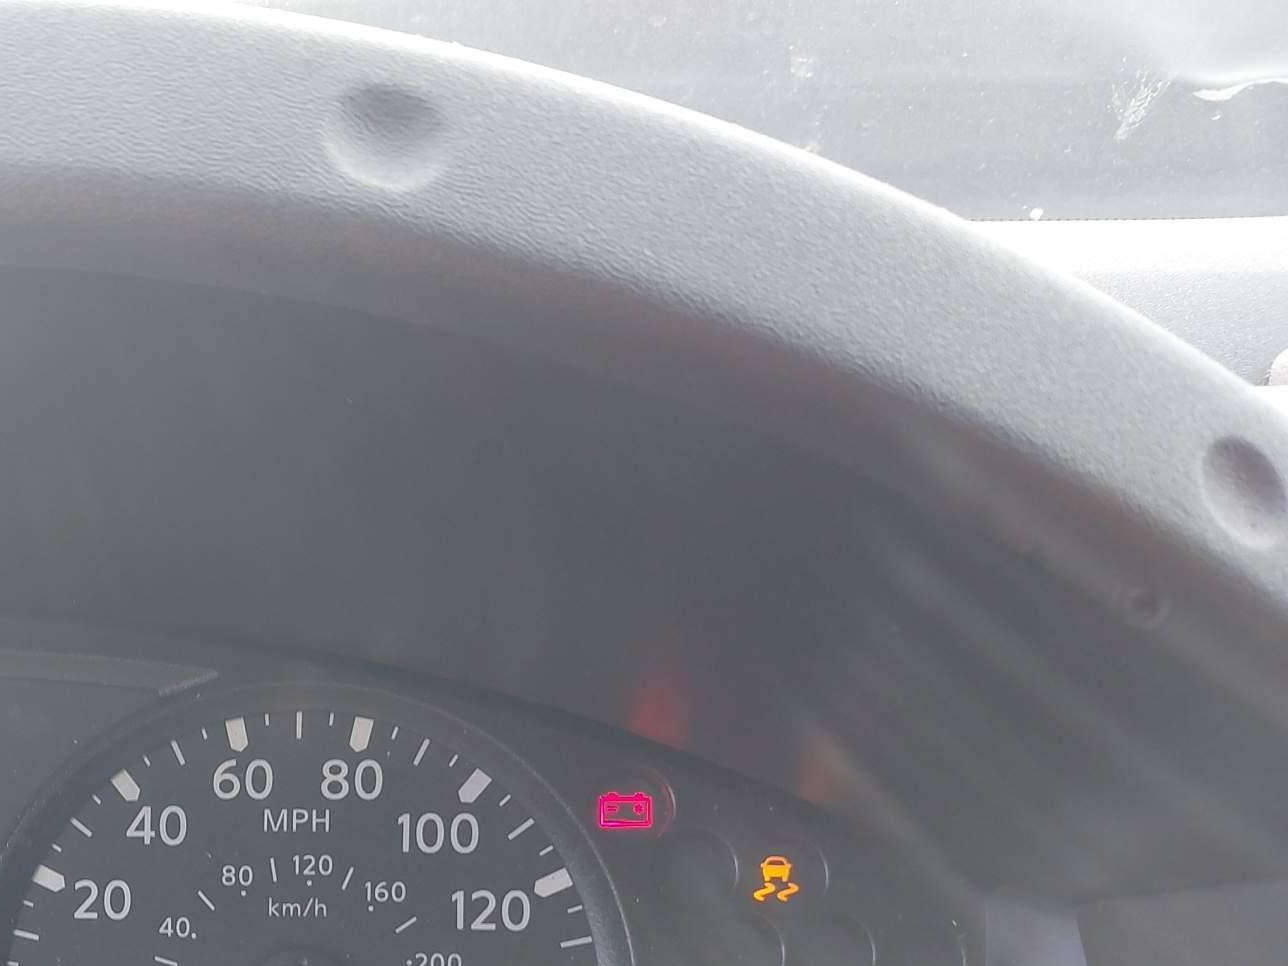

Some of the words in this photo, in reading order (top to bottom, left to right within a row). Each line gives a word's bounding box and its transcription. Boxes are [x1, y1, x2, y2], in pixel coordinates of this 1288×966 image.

[214, 759, 273, 800] 60
[321, 759, 383, 800] 80
[127, 806, 187, 846] 40
[263, 809, 331, 833] MPH
[398, 813, 479, 854] 100
[221, 864, 253, 887] 80
[292, 855, 333, 877] 120
[74, 880, 132, 921] 20
[267, 897, 328, 919] km/h
[365, 881, 406, 904] 160
[452, 890, 531, 932] 120
[159, 917, 191, 939] 40
